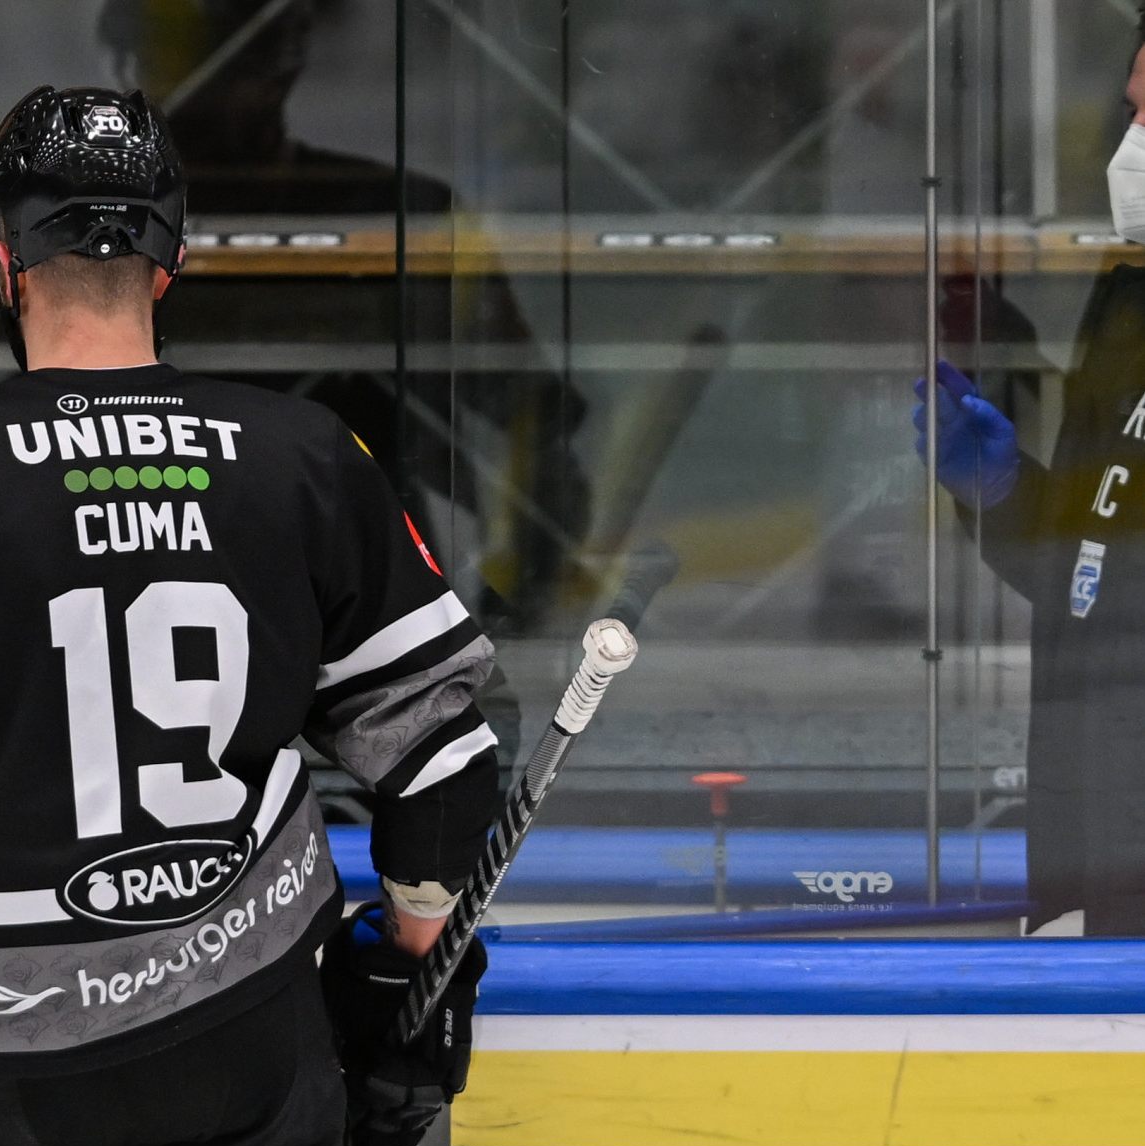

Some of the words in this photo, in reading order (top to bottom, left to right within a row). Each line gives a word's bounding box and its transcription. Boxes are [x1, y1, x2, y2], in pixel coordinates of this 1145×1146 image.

[94, 396, 184, 405] WARRIOR
[6, 414, 242, 465] UNIBET
[75, 502, 213, 555] CUMA
[48, 580, 249, 839] 19
